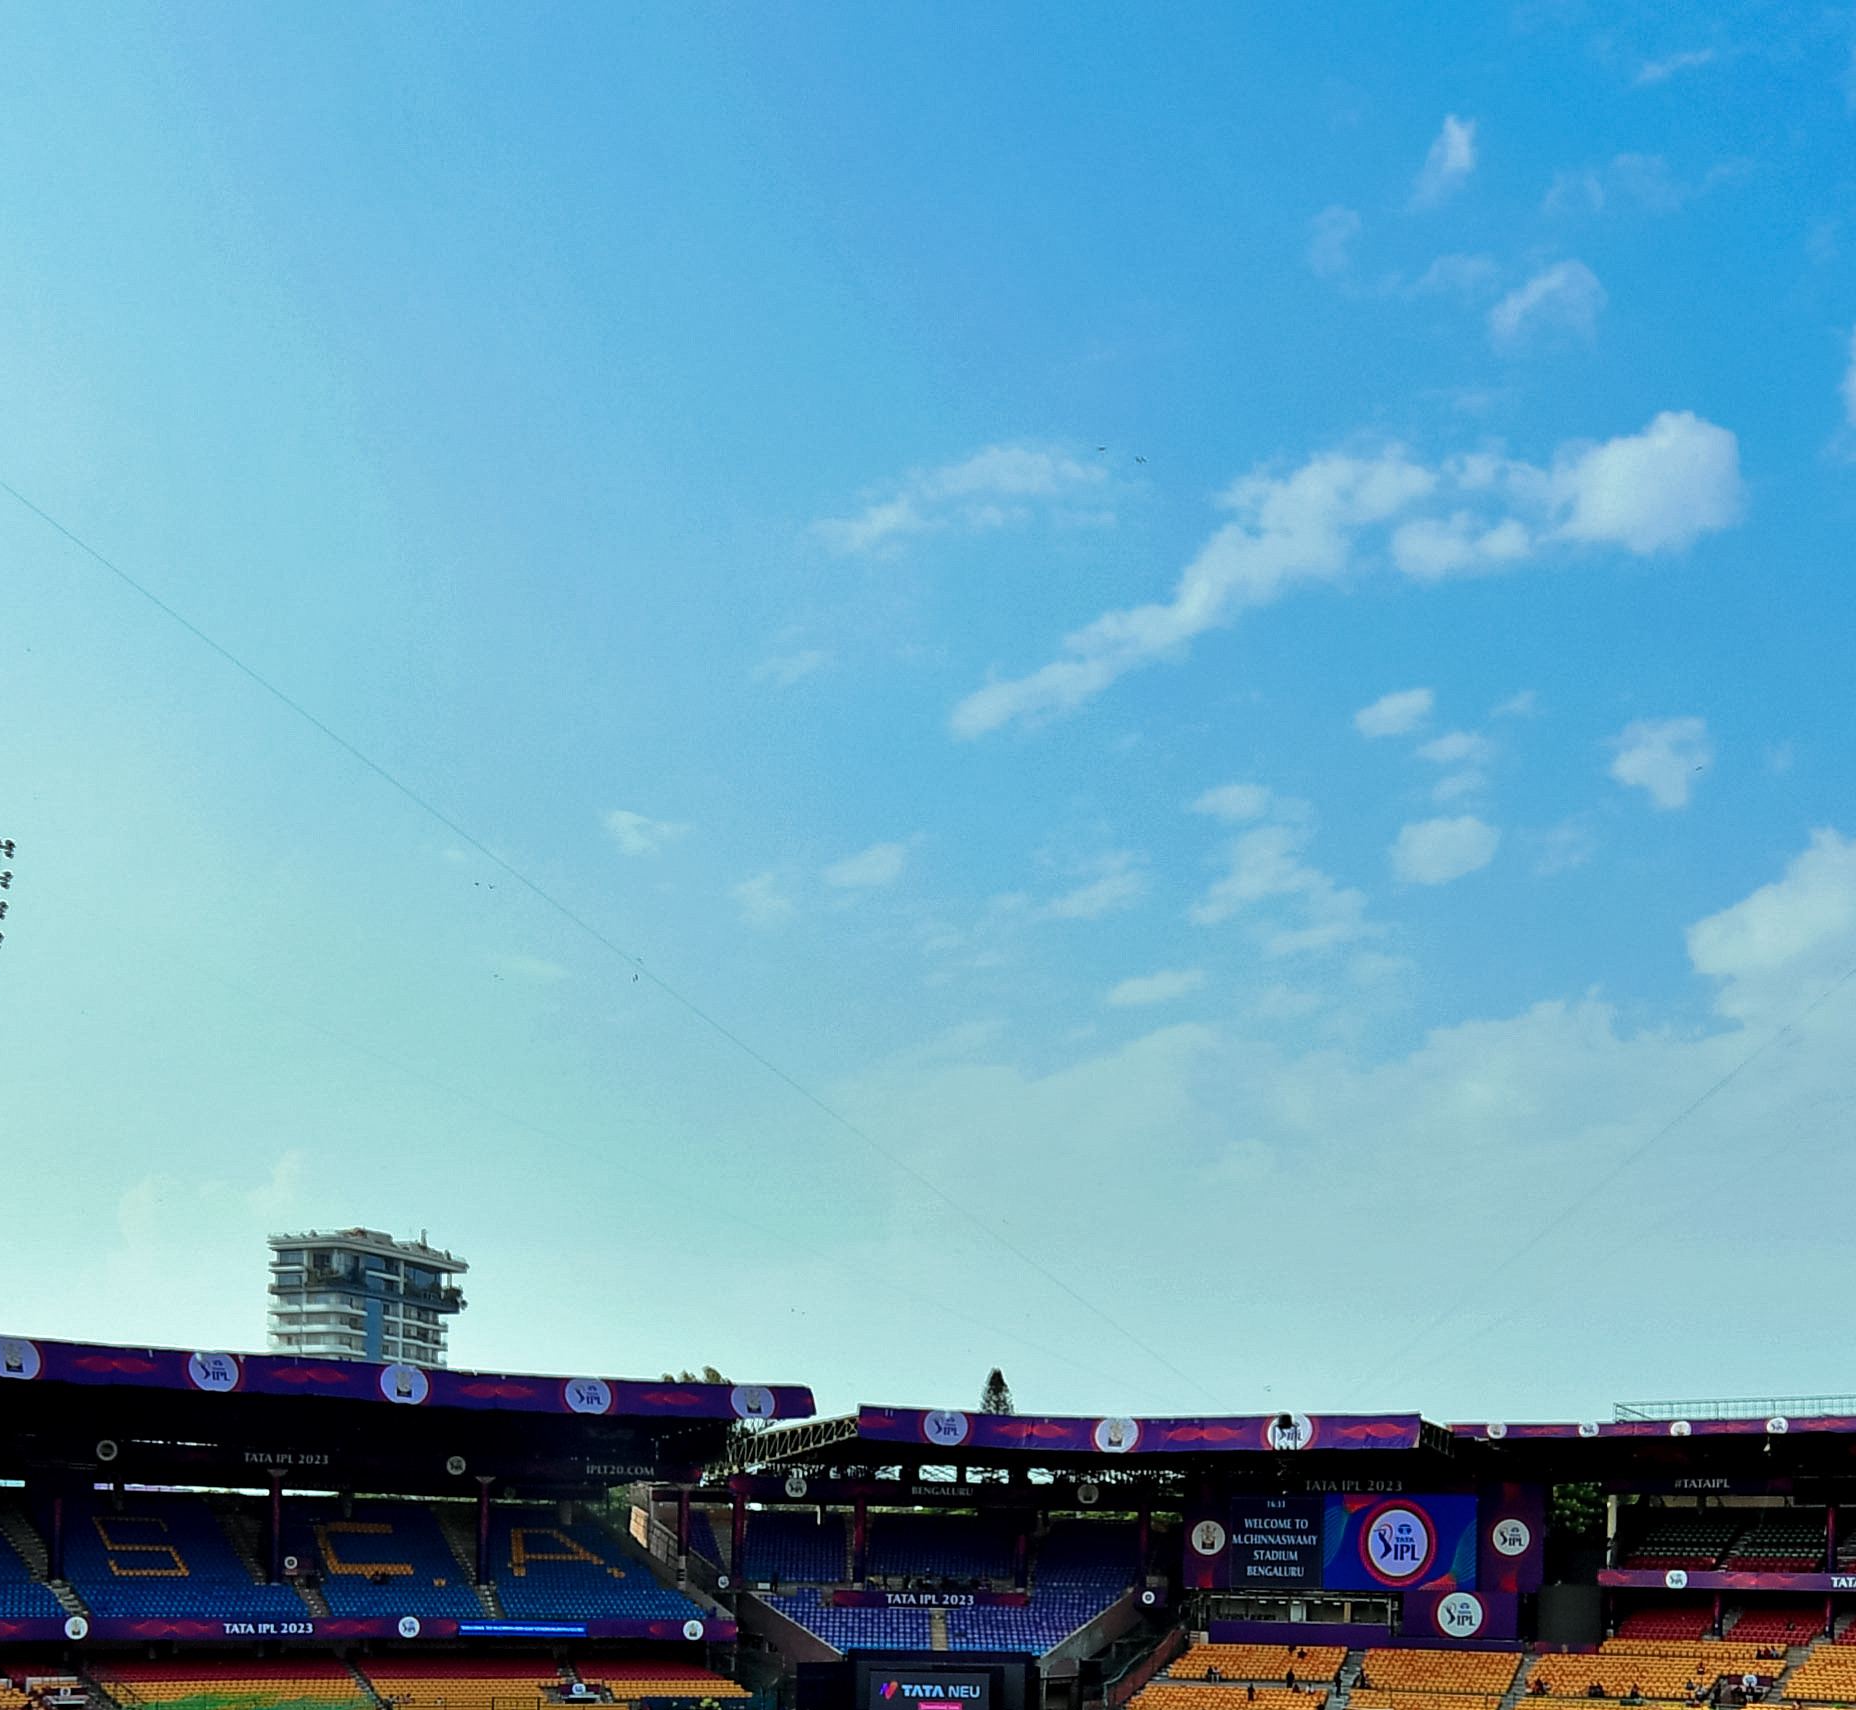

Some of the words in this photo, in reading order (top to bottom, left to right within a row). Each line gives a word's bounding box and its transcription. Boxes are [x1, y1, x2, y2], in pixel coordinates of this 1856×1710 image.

[211, 1370, 231, 1383] IPL
[243, 1452, 274, 1465] TATA
[276, 1453, 295, 1465] IPL
[298, 1454, 330, 1466] 2023
[586, 1463, 656, 1477] IPLT20.COM
[1305, 1480, 1338, 1492] TATA
[1342, 1480, 1363, 1492] IPL
[1367, 1480, 1403, 1492] 2023
[1674, 1478, 1732, 1489] #TATAIPL
[911, 1485, 974, 1498] BENGALURU
[1244, 1518, 1291, 1530] WELCOME
[1293, 1519, 1308, 1530] TO
[1508, 1538, 1524, 1547] IPL
[1253, 1550, 1298, 1562] STADIUM
[1394, 1545, 1421, 1561] IPL
[1246, 1566, 1305, 1578] BENGALURU
[885, 1592, 917, 1606] TATA
[920, 1593, 939, 1607] IPL
[941, 1594, 976, 1608] 2023
[1457, 1615, 1476, 1626] IPL
[223, 1622, 251, 1634] TATA
[257, 1622, 278, 1634] IPL
[280, 1622, 314, 1634] 2023
[901, 1684, 944, 1698] TATA
[948, 1684, 981, 1699] NEU
